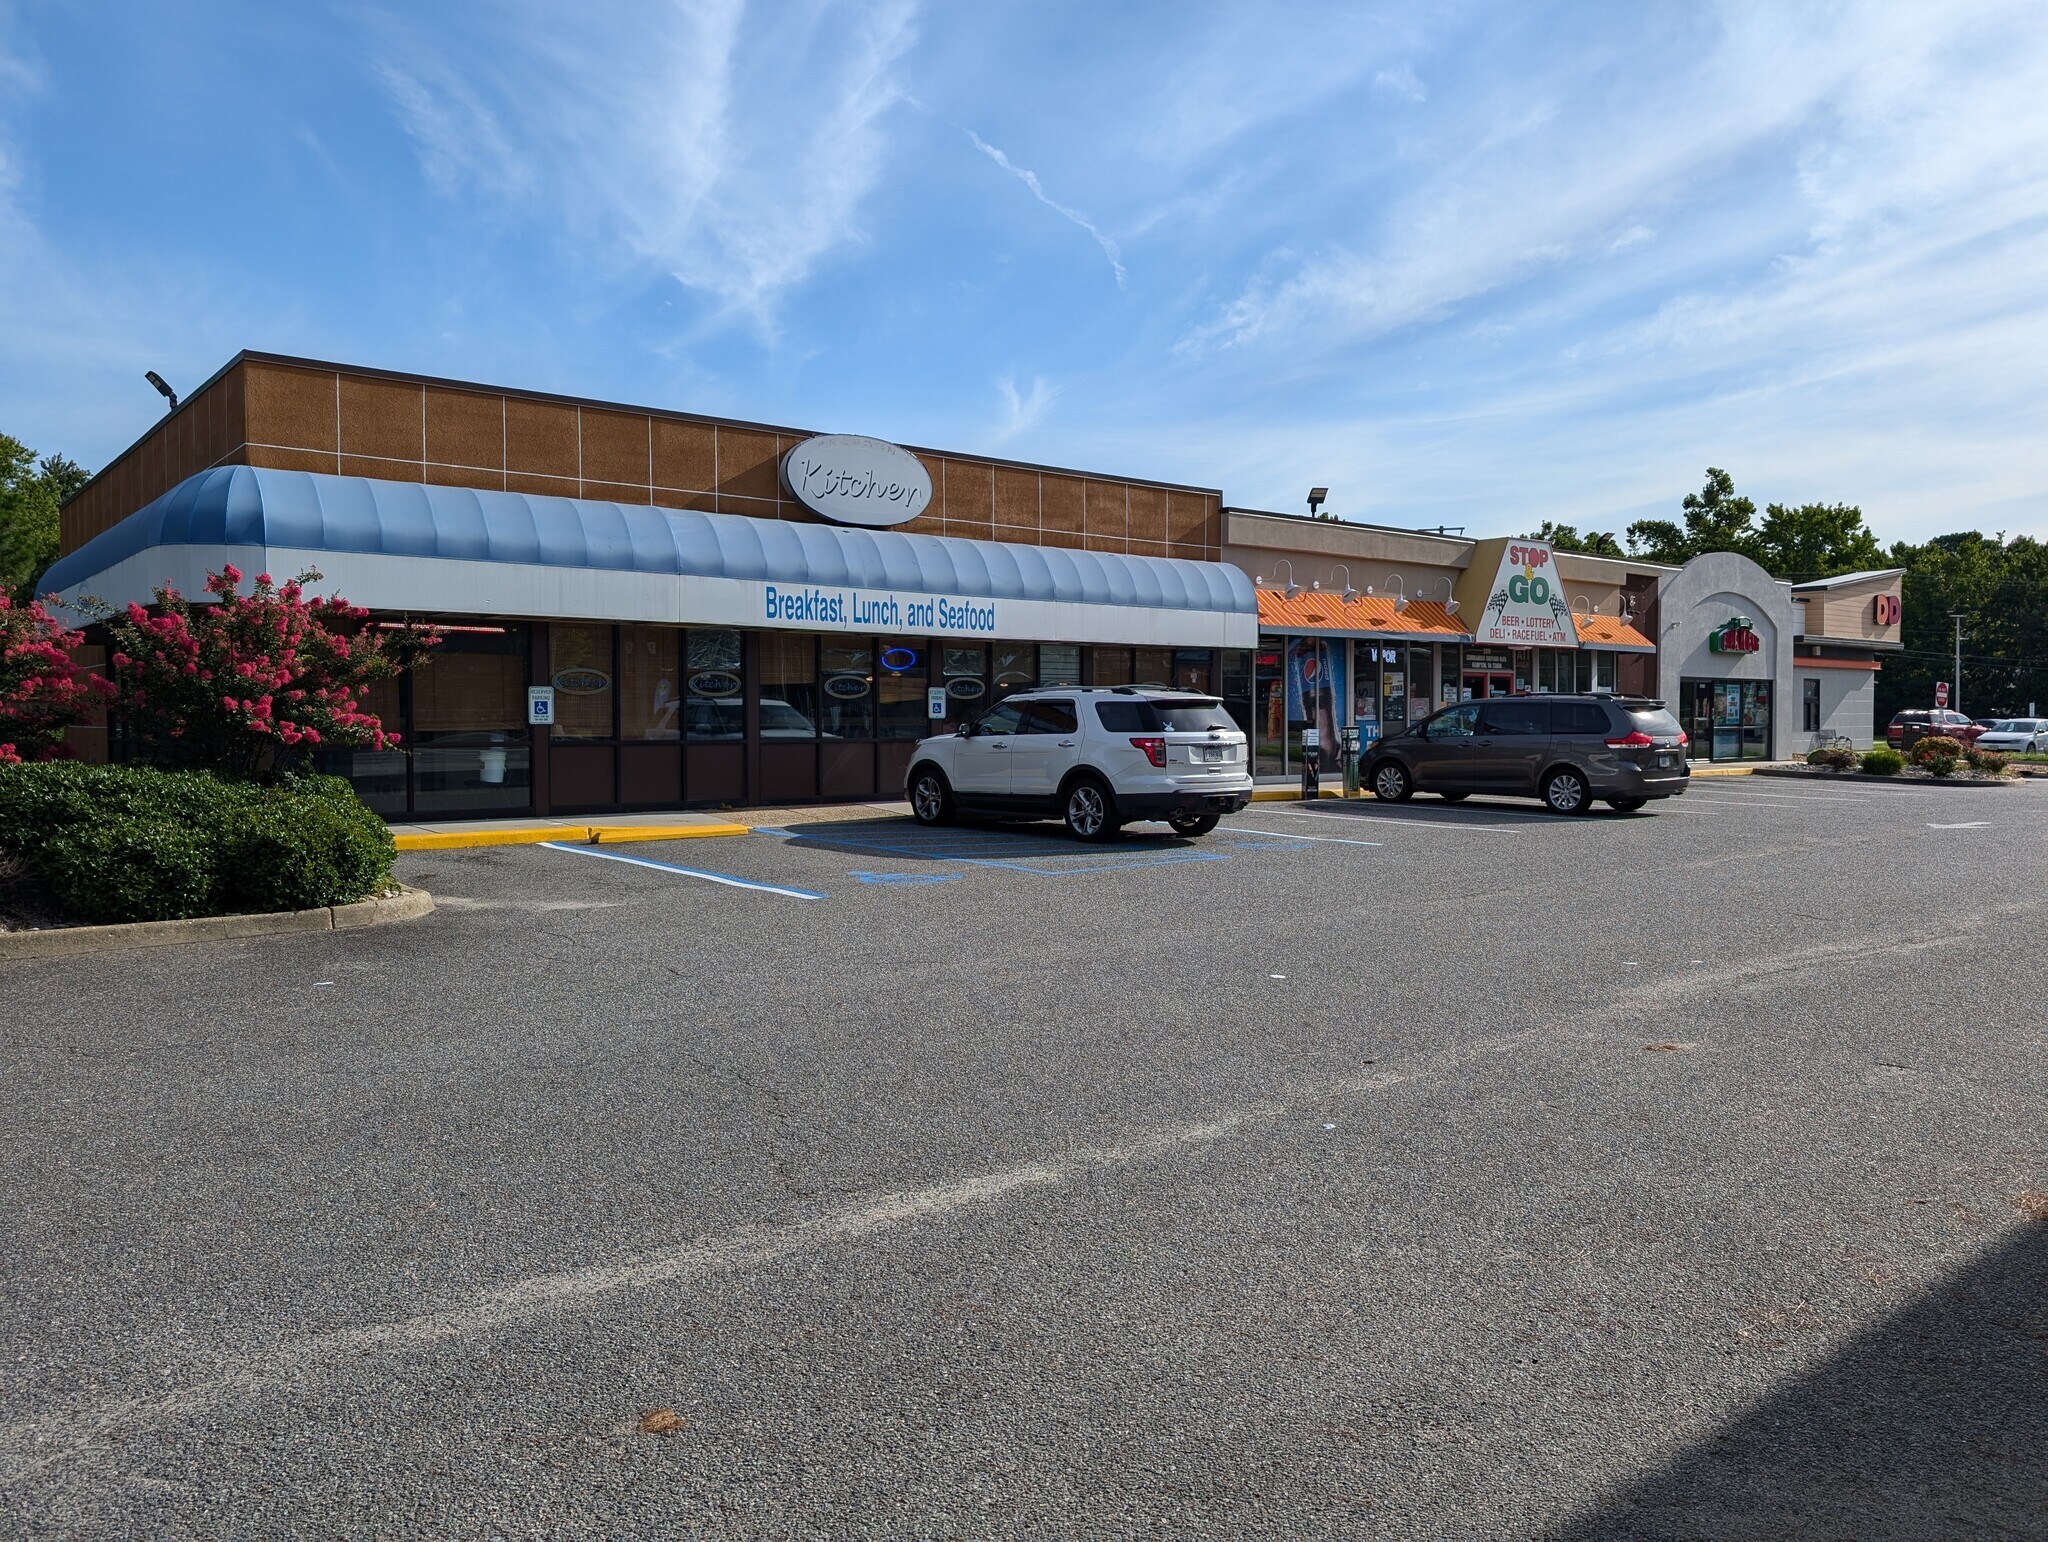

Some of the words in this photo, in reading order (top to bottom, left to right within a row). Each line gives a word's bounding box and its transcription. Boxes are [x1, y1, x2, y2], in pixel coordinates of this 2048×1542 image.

[801, 459, 922, 508] Kitchen
[1509, 545, 1549, 568] STOP
[1524, 562, 1534, 581] &
[1508, 574, 1550, 605] GO
[766, 586, 847, 629] Breakfast,
[853, 592, 902, 631] Lunch,
[908, 598, 934, 628] and
[939, 598, 995, 631] Seafood
[1502, 615, 1520, 627] BEER
[1526, 616, 1555, 629] LOTTERY
[1489, 628, 1506, 639] DELI
[1552, 631, 1566, 642] ATM
[1371, 648, 1396, 664] VPOR
